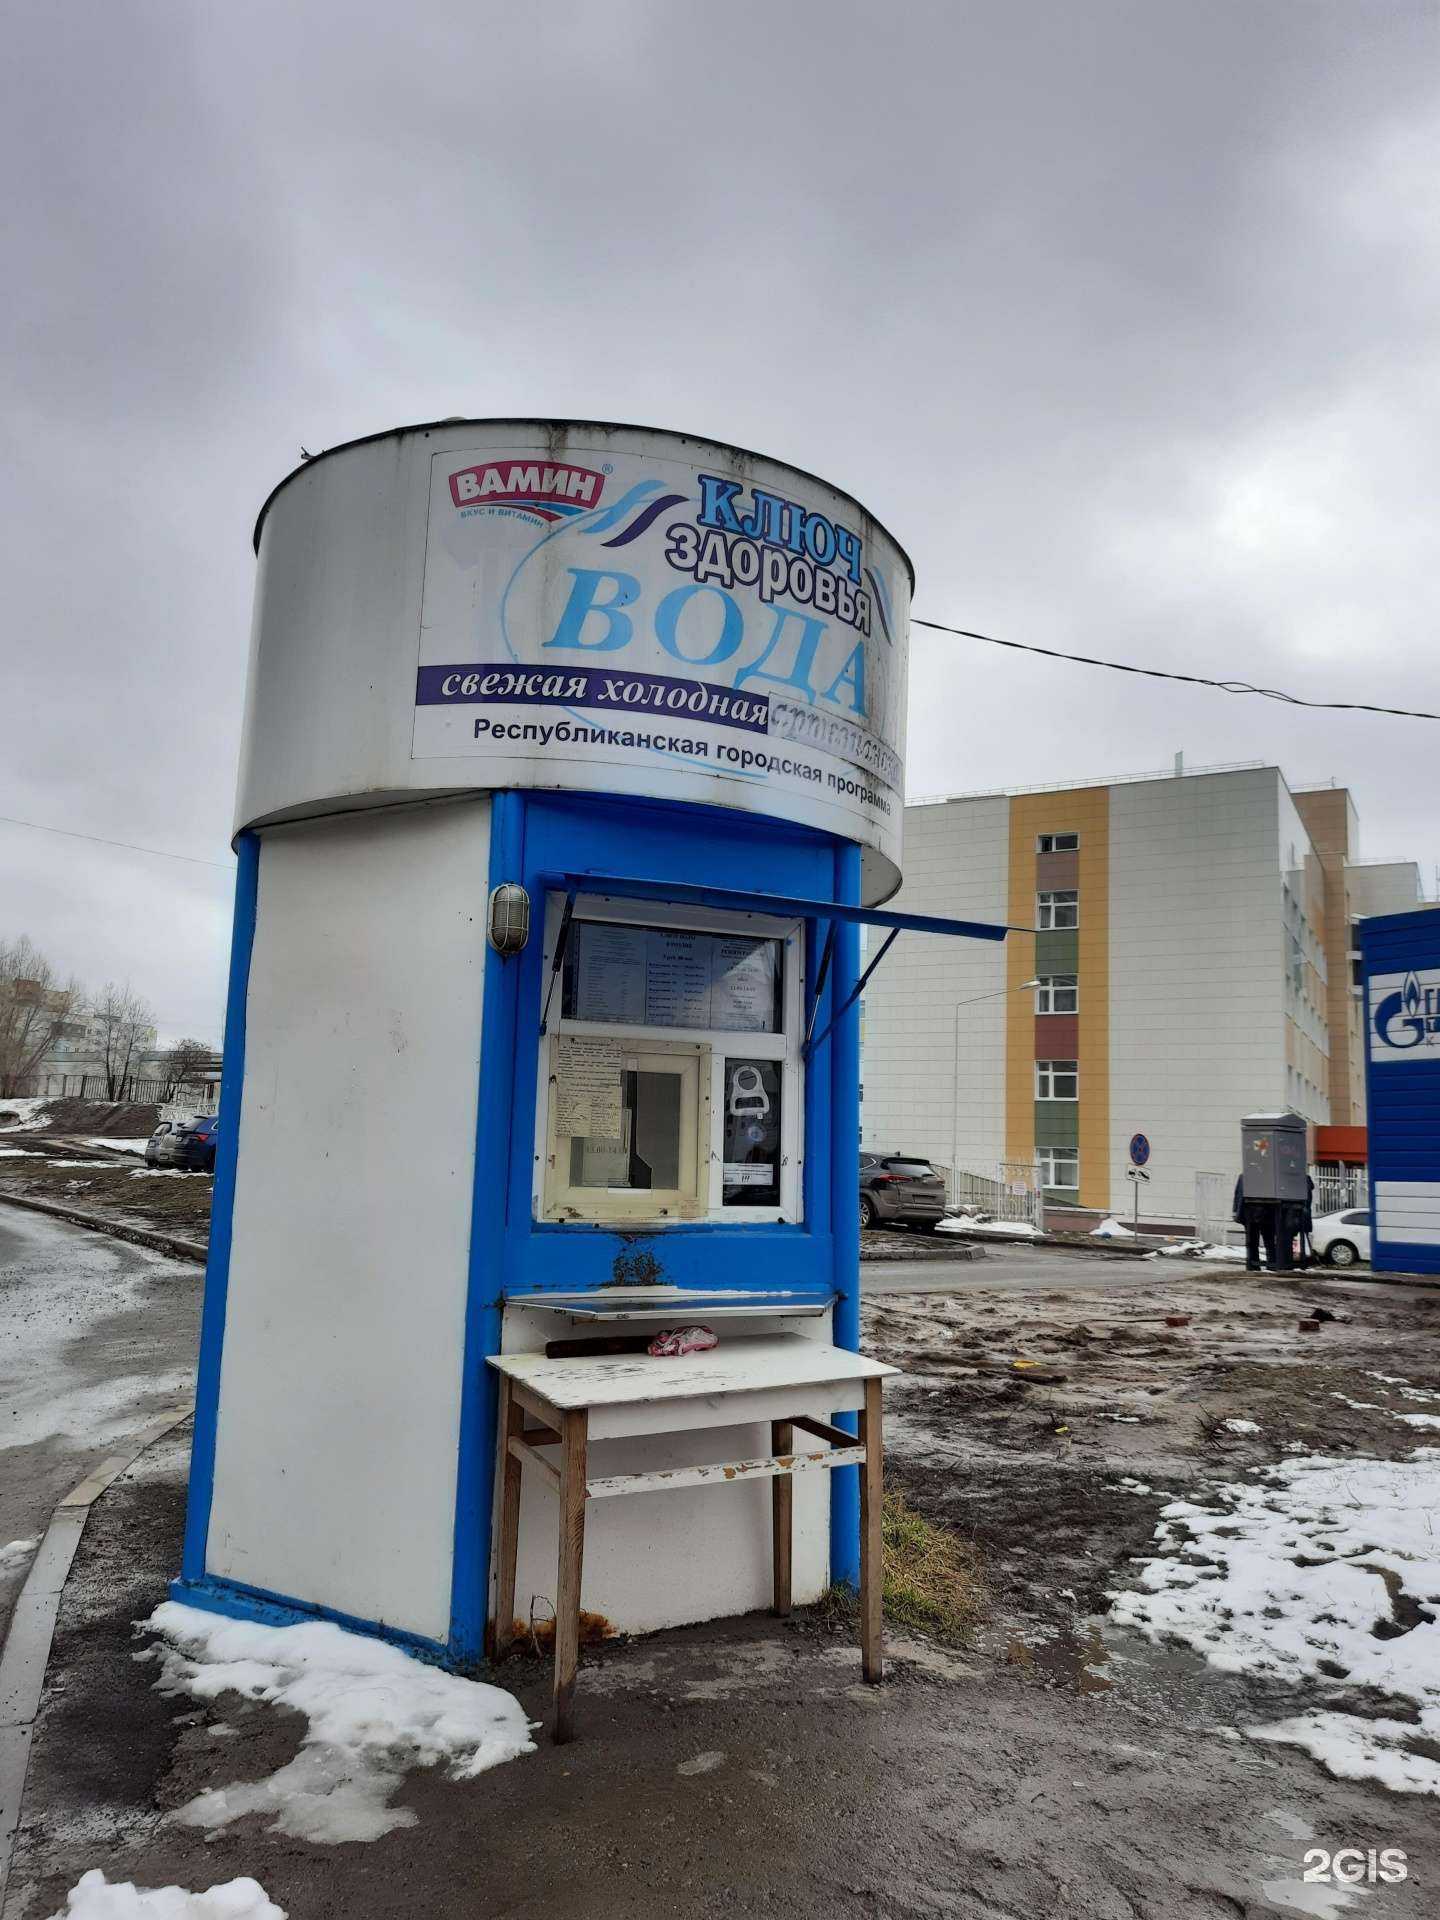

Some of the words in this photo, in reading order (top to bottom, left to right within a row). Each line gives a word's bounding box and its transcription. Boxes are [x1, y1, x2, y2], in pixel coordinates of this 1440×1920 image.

[456, 466, 596, 502] ВАМИН
[697, 474, 862, 585] КЛЮЧ
[541, 566, 869, 719] ВОДА
[441, 670, 588, 698] свежая
[597, 682, 769, 728] холодная
[474, 718, 708, 757] Республиканская
[716, 745, 822, 783] городская
[827, 773, 892, 817] программа
